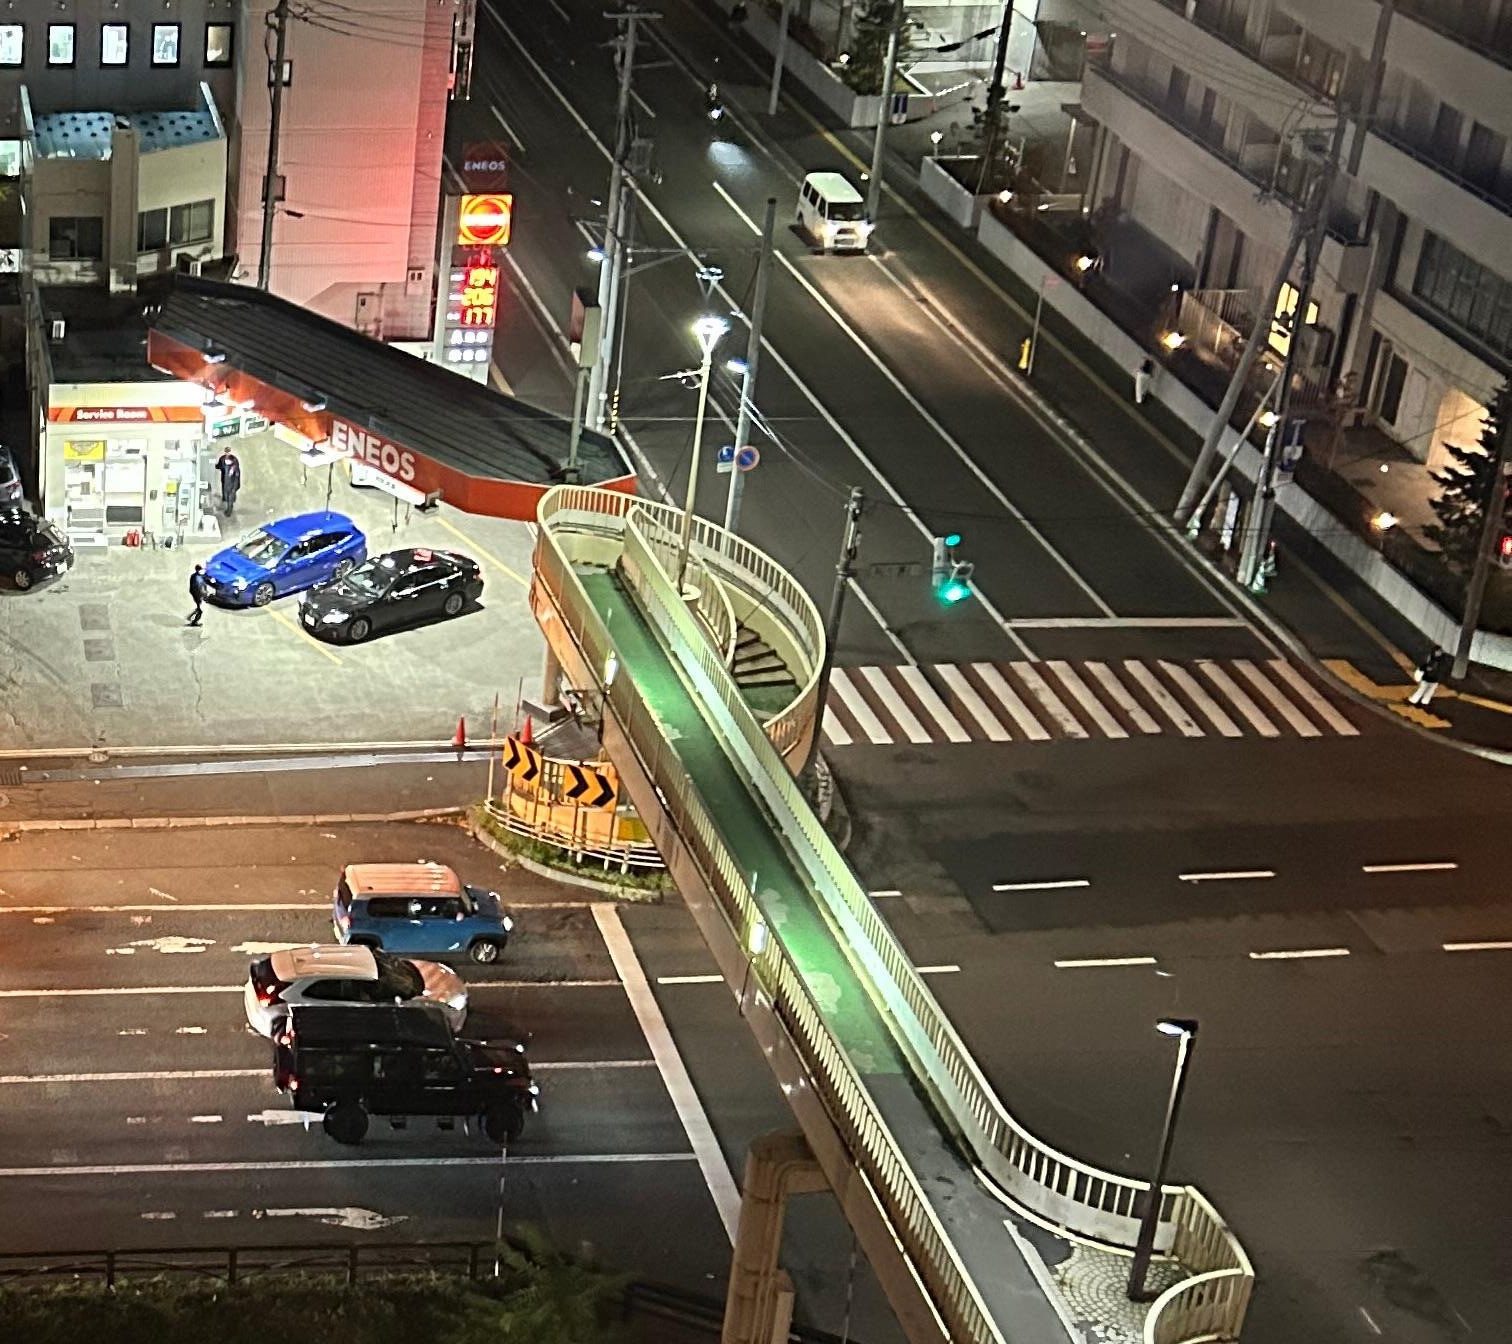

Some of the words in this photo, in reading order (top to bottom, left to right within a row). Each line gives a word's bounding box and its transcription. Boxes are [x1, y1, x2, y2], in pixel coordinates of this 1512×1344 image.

[464, 160, 505, 171] ENEOS
[76, 408, 115, 420] Service
[331, 420, 416, 482] ENEOS
